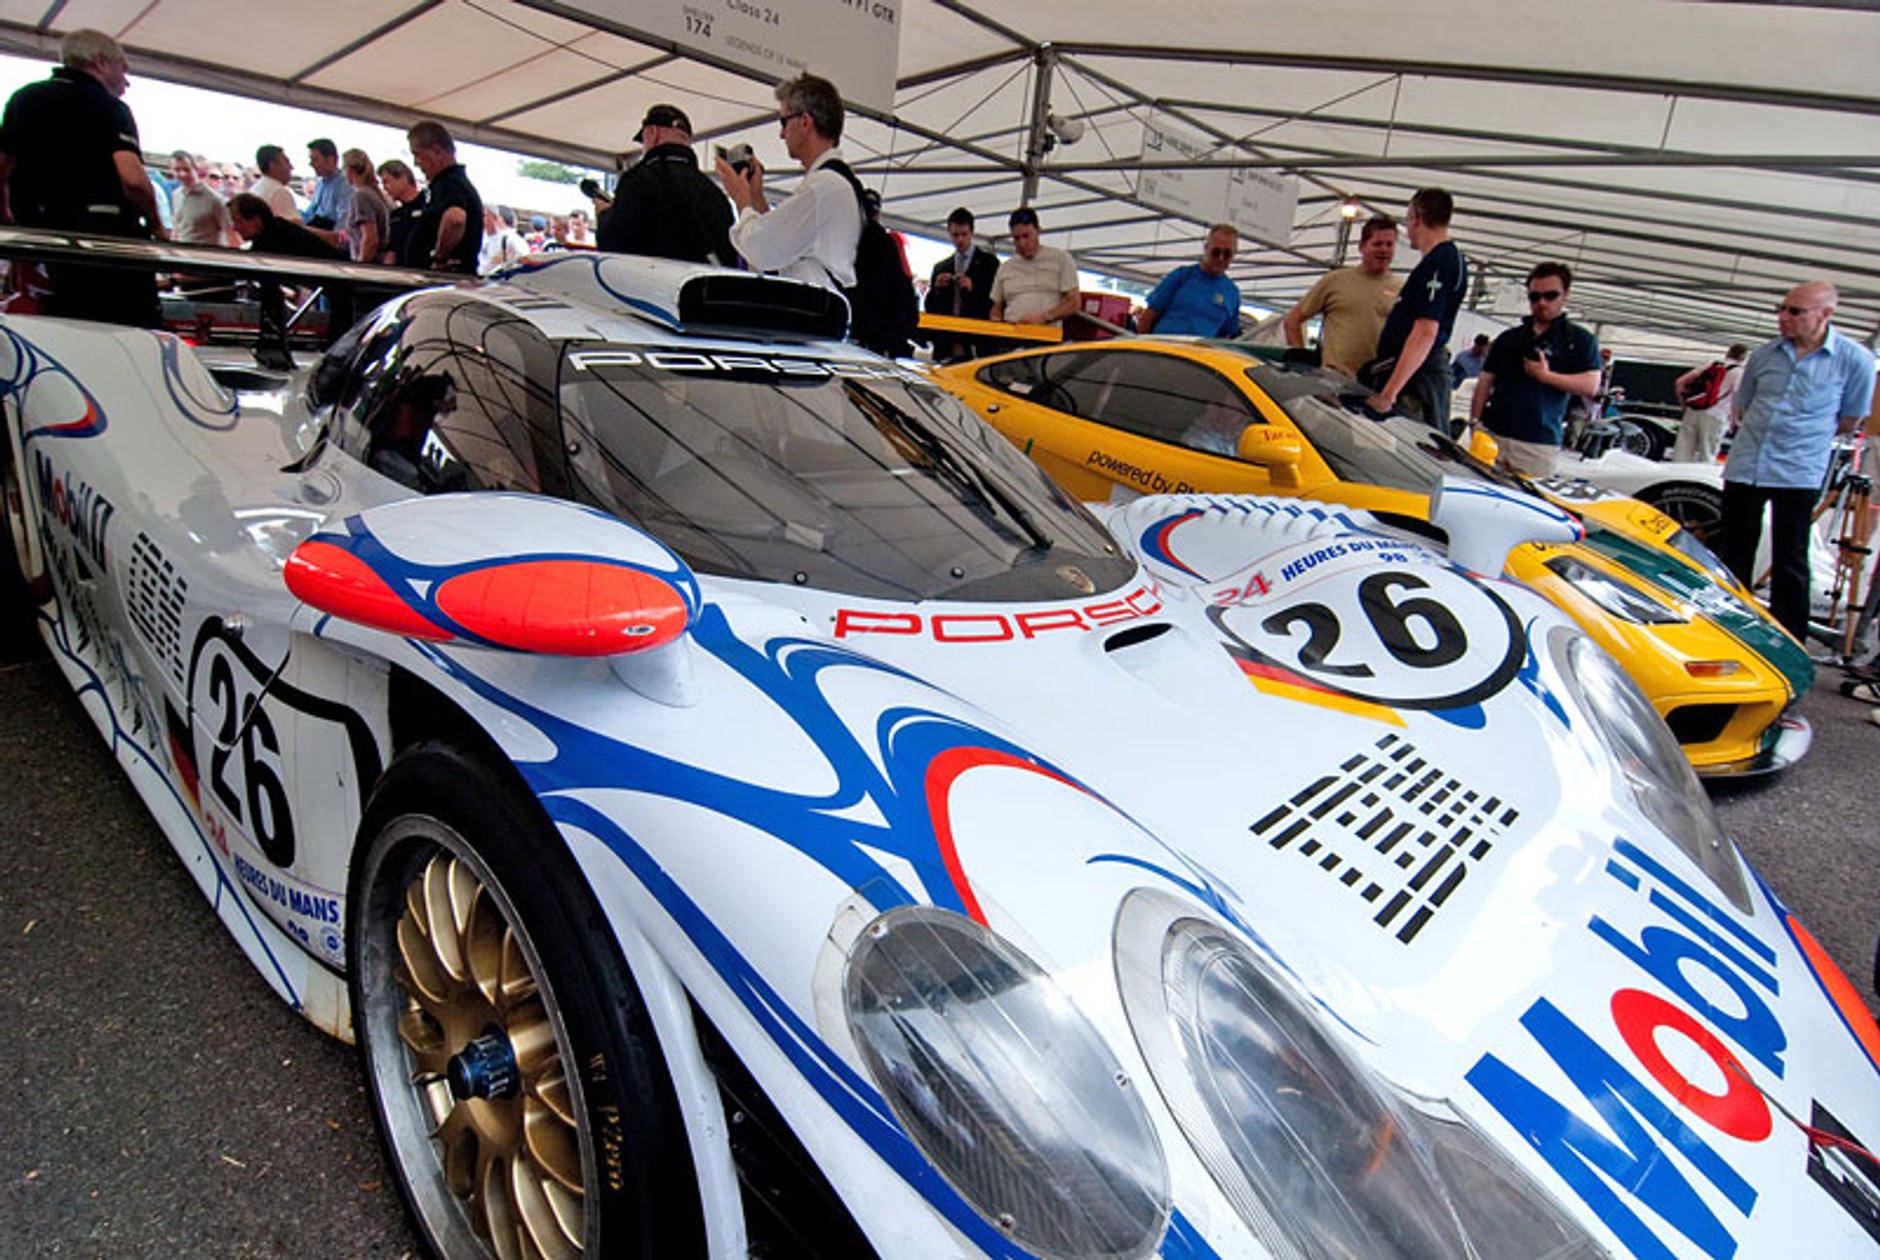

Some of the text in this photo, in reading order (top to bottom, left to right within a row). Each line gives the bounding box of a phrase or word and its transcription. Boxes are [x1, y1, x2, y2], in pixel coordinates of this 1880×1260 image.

[686, 16, 711, 38] 174
[727, 0, 780, 26] Class 24
[872, 3, 894, 23] GTR
[1087, 451, 1151, 486] powered
[1213, 570, 1273, 605] 24
[1281, 543, 1348, 582] HEURES
[1348, 541, 1374, 552] DU
[1261, 571, 1468, 678] 26
[210, 652, 296, 868] 26
[233, 851, 269, 895] HEURES
[268, 878, 287, 907] DU
[288, 888, 340, 924] MANS
[1463, 836, 1788, 1260] Mobil
